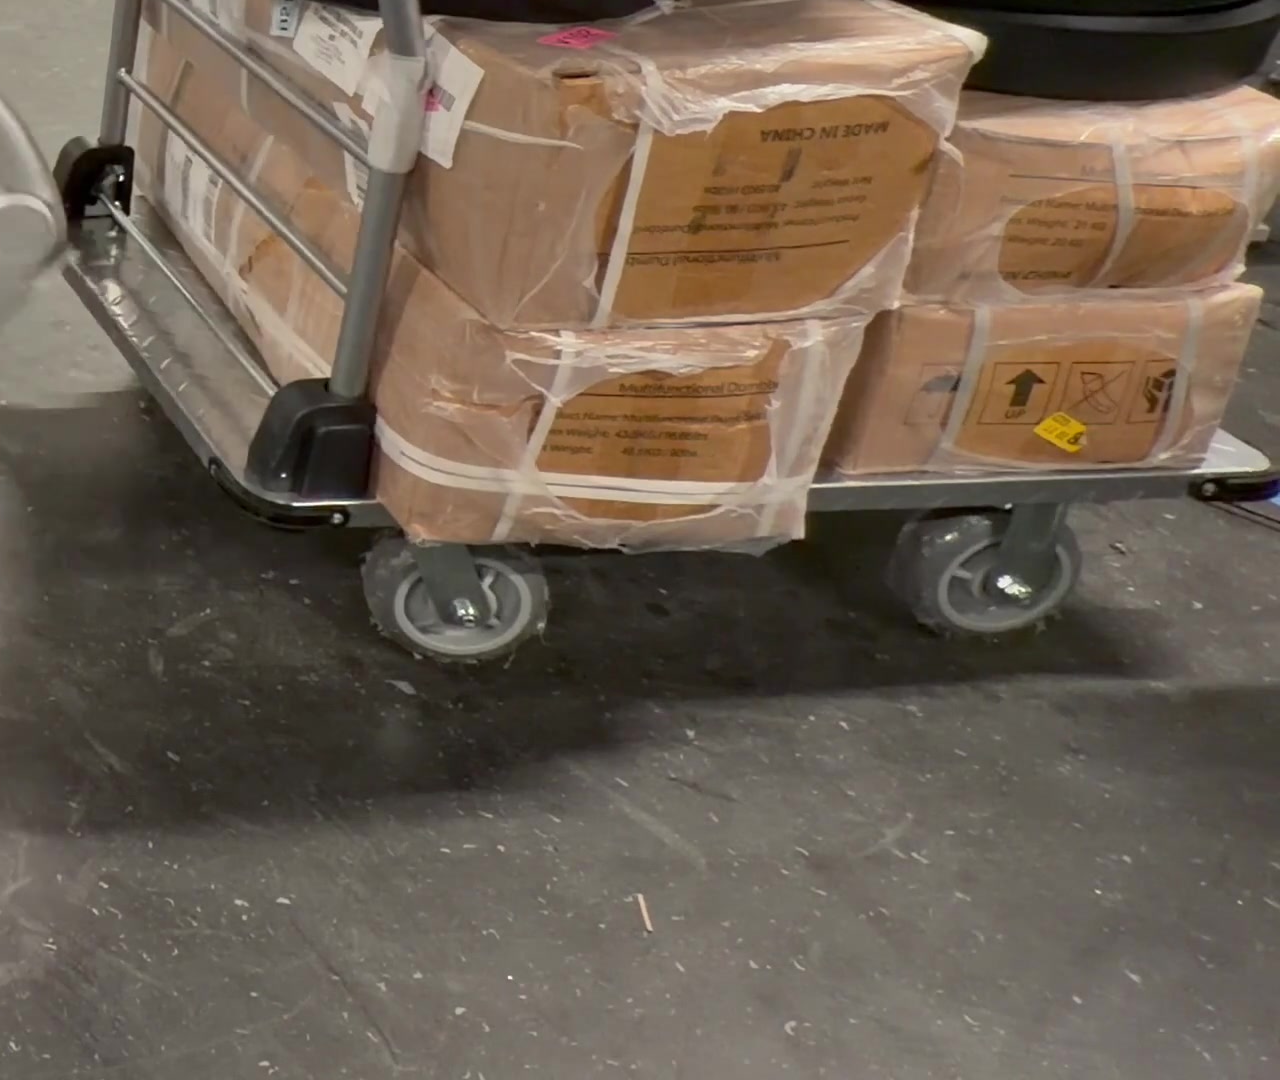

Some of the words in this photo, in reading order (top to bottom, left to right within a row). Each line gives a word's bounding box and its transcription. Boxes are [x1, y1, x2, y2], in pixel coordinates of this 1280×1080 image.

[759, 126, 817, 145] CHINA
[818, 125, 838, 141] IN
[841, 120, 890, 139] MADE
[618, 381, 724, 394] Multifunctional
